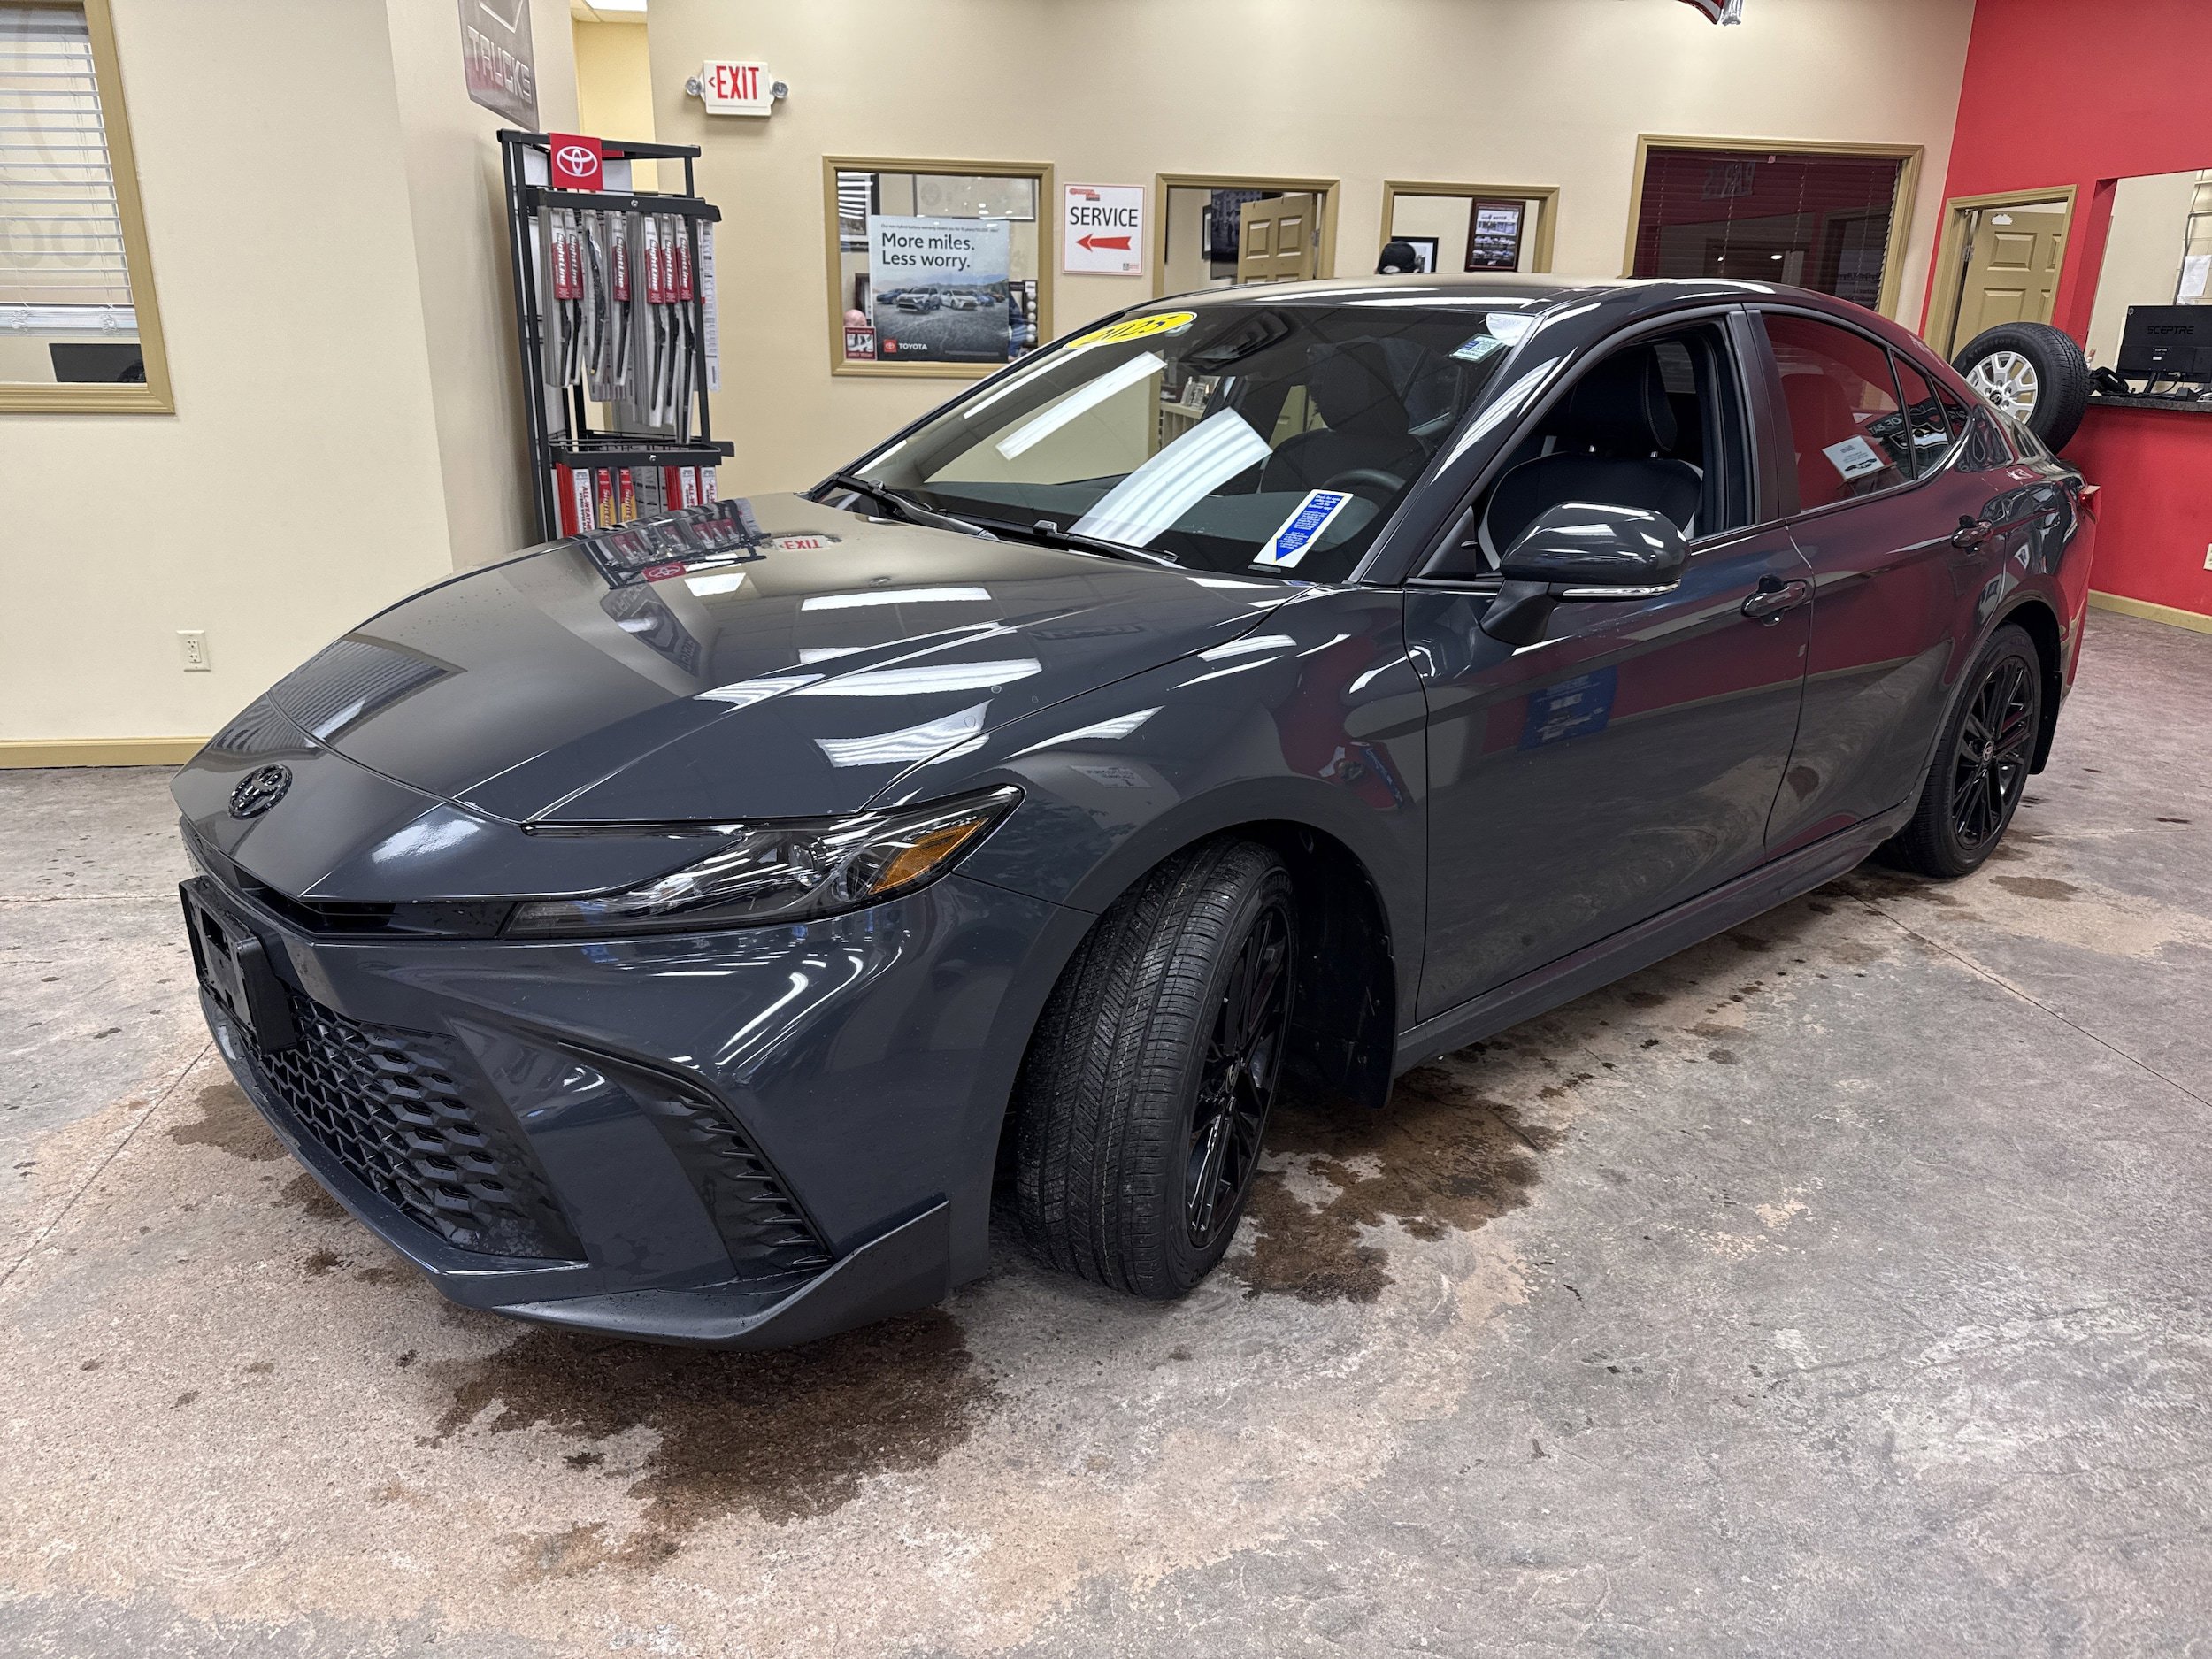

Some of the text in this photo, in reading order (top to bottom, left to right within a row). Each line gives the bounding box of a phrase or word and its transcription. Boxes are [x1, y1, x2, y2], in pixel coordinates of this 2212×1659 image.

[466, 25, 533, 104] TRUCKS
[715, 65, 760, 100] EXIT
[881, 232, 975, 251] More miles.
[1069, 206, 1139, 227] SERVICE
[557, 232, 566, 287] SightLine
[570, 234, 580, 287] SightLine
[616, 236, 625, 288] SightLine
[649, 239, 659, 291] SightLine
[665, 239, 674, 291] SightLine
[680, 237, 689, 288] SightLine
[882, 250, 971, 271] Less worry.
[2147, 325, 2195, 335] SCEPTRE
[582, 486, 593, 532] ALL-WEATHE
